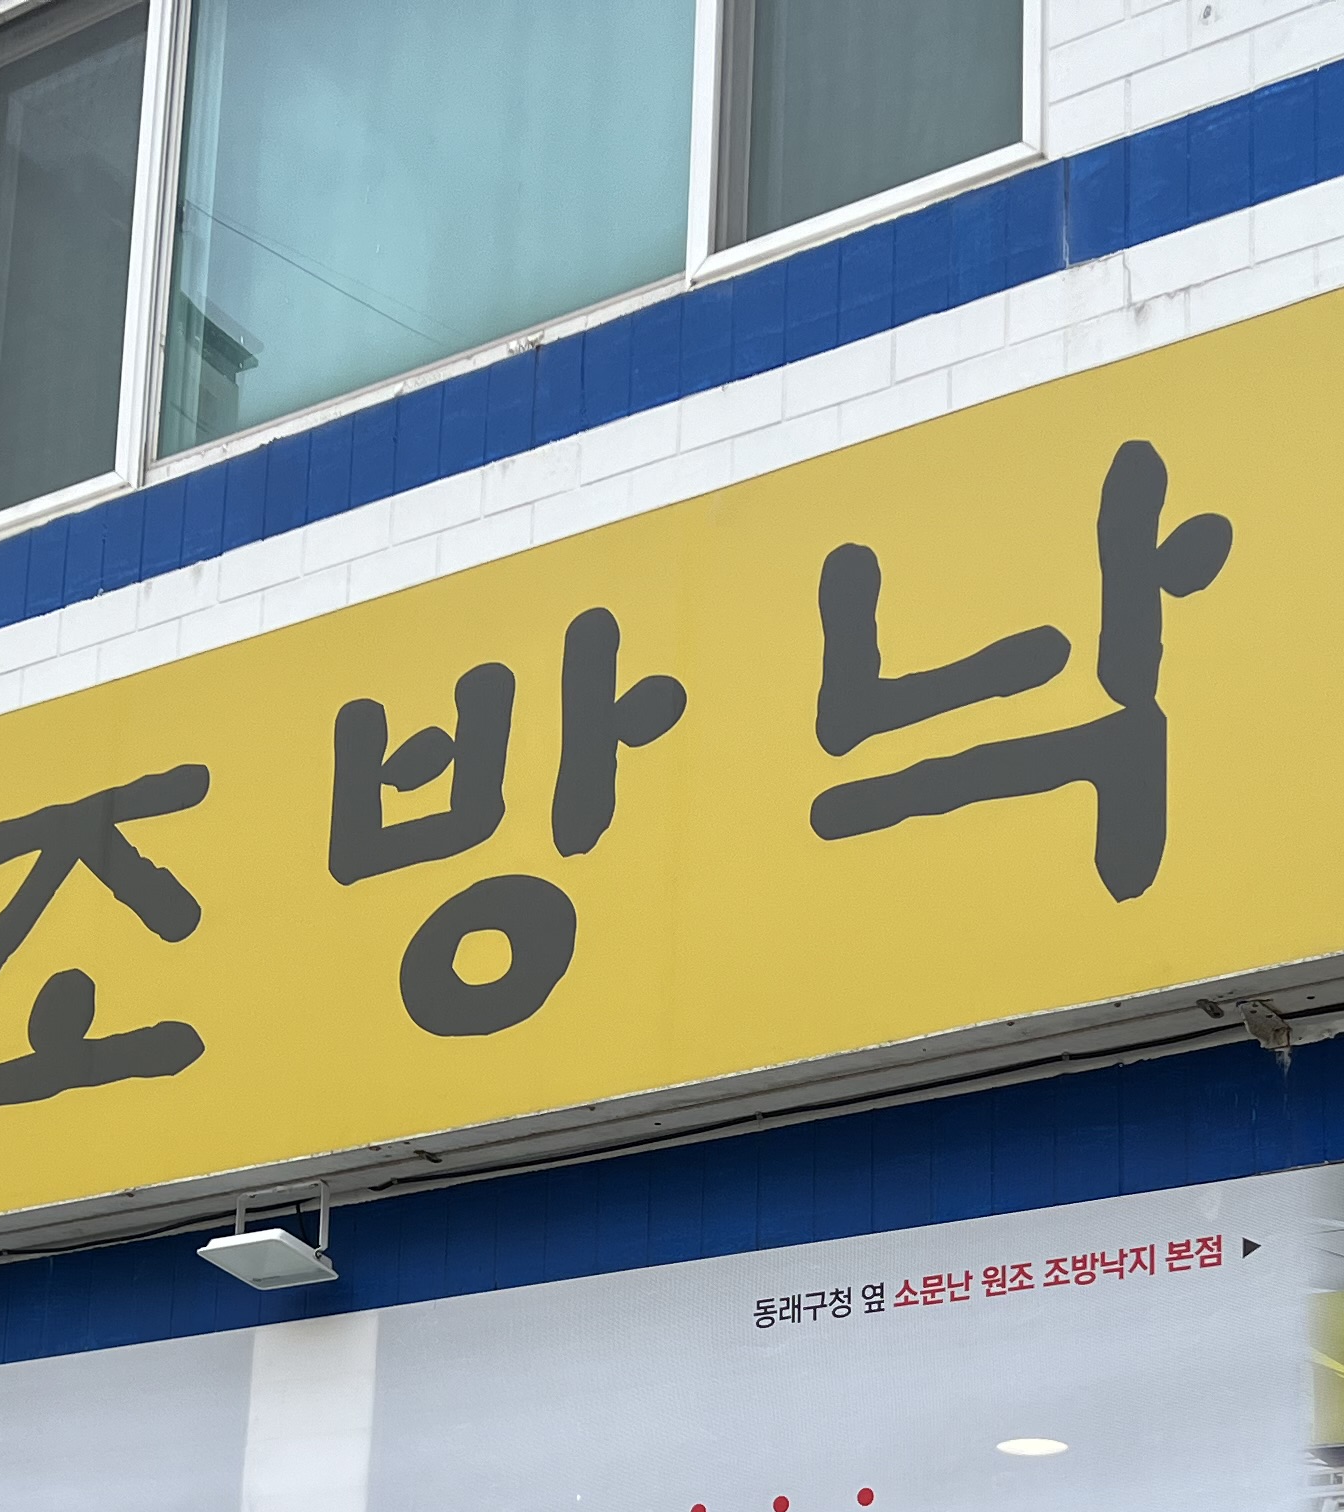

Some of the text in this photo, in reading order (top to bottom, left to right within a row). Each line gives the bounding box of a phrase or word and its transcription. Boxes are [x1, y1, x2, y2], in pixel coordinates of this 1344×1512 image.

[753, 1234, 1224, 1330] 동래구청 옆 소문난 원조 조방낙지 본점
